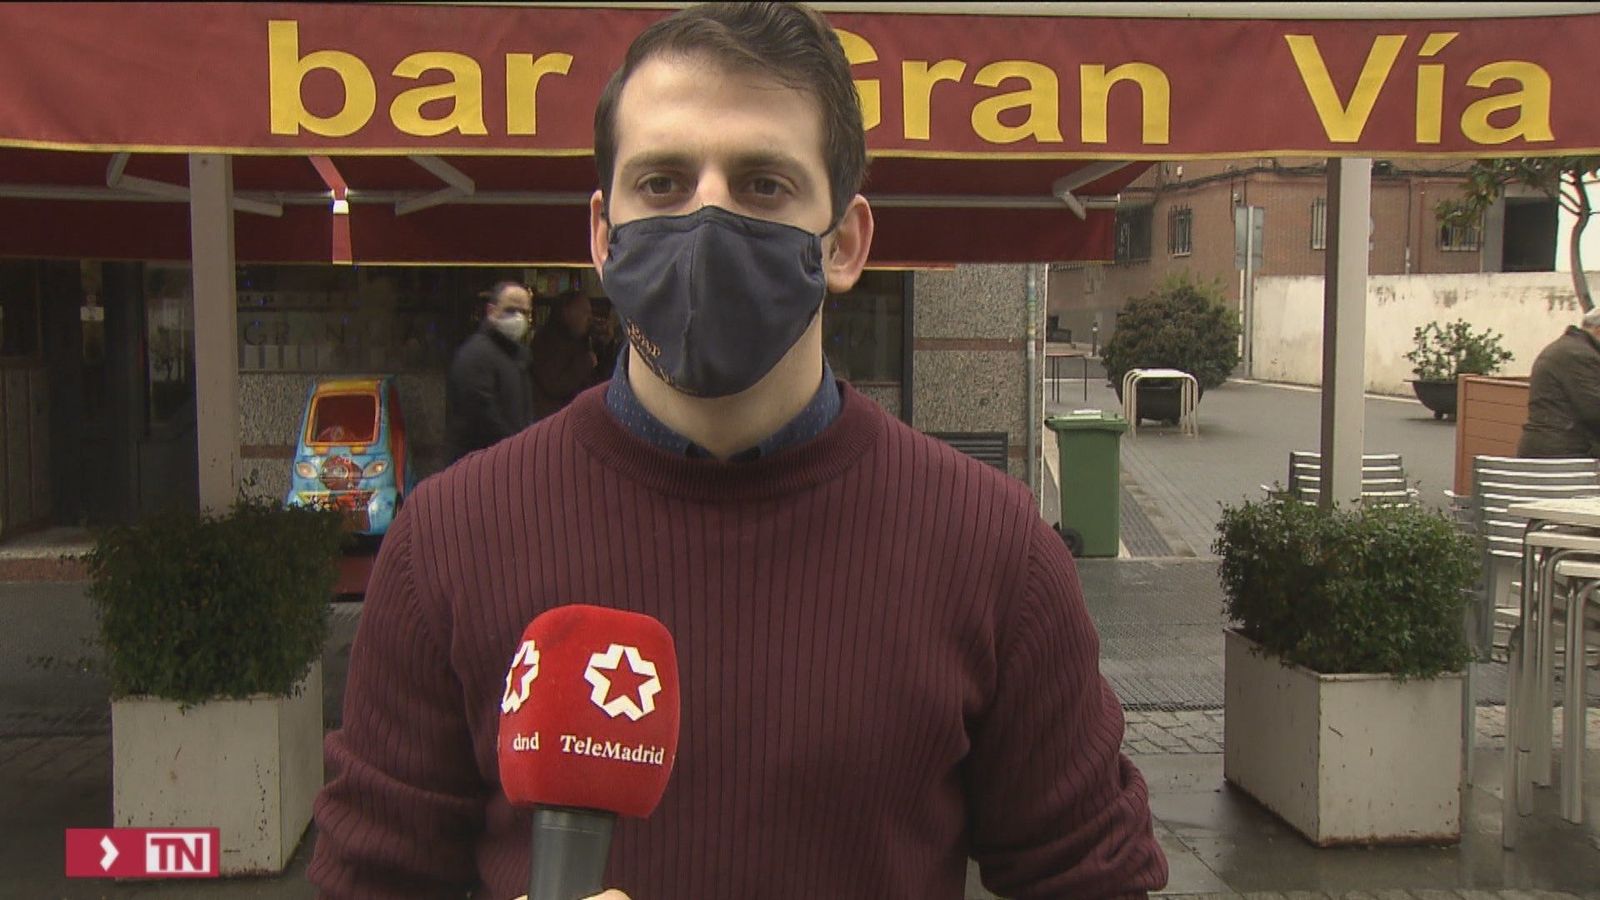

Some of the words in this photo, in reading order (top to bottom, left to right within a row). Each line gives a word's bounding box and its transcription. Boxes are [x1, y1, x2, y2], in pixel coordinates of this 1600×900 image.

[268, 20, 573, 138] bar
[1285, 31, 1554, 144] Vía
[560, 734, 665, 765] TeleMadrid
